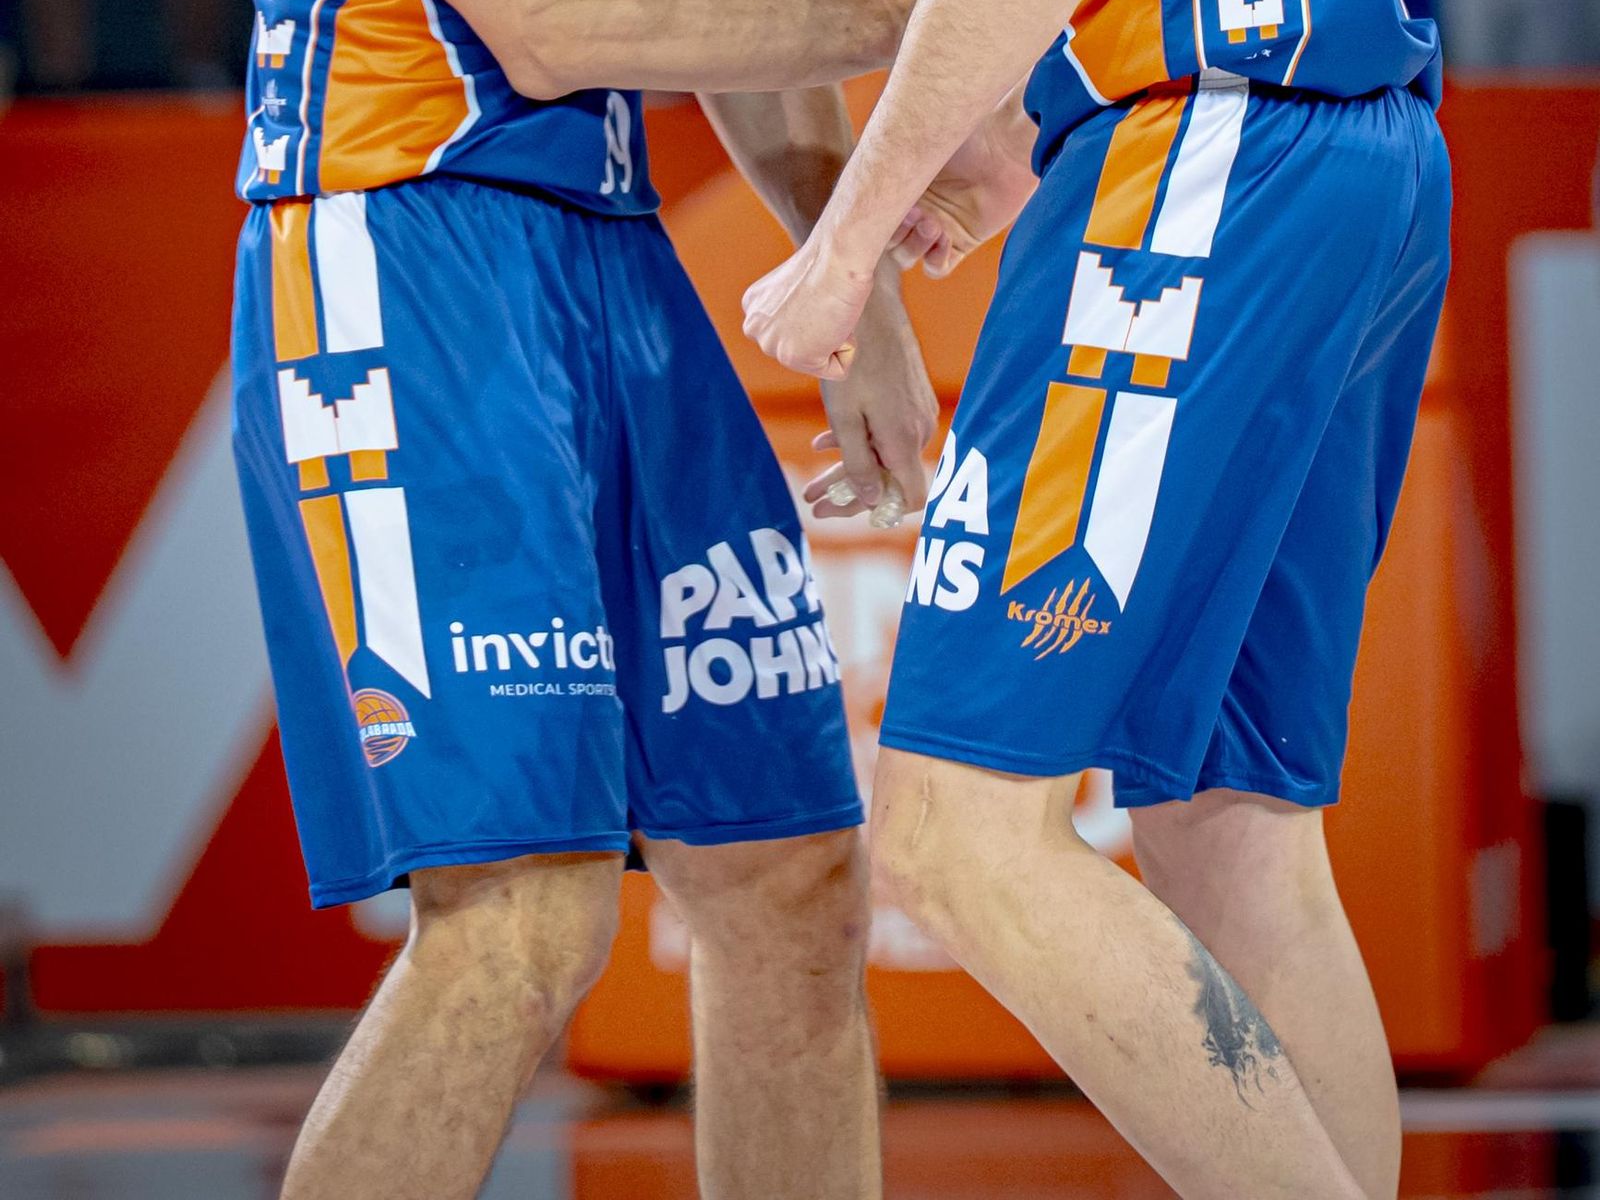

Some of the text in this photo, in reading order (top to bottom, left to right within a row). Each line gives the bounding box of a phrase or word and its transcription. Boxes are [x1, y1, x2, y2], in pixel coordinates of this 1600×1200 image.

[1007, 600, 1112, 635] Kromex
[661, 621, 842, 714] JOHN
[490, 683, 565, 696] MEDICAL
